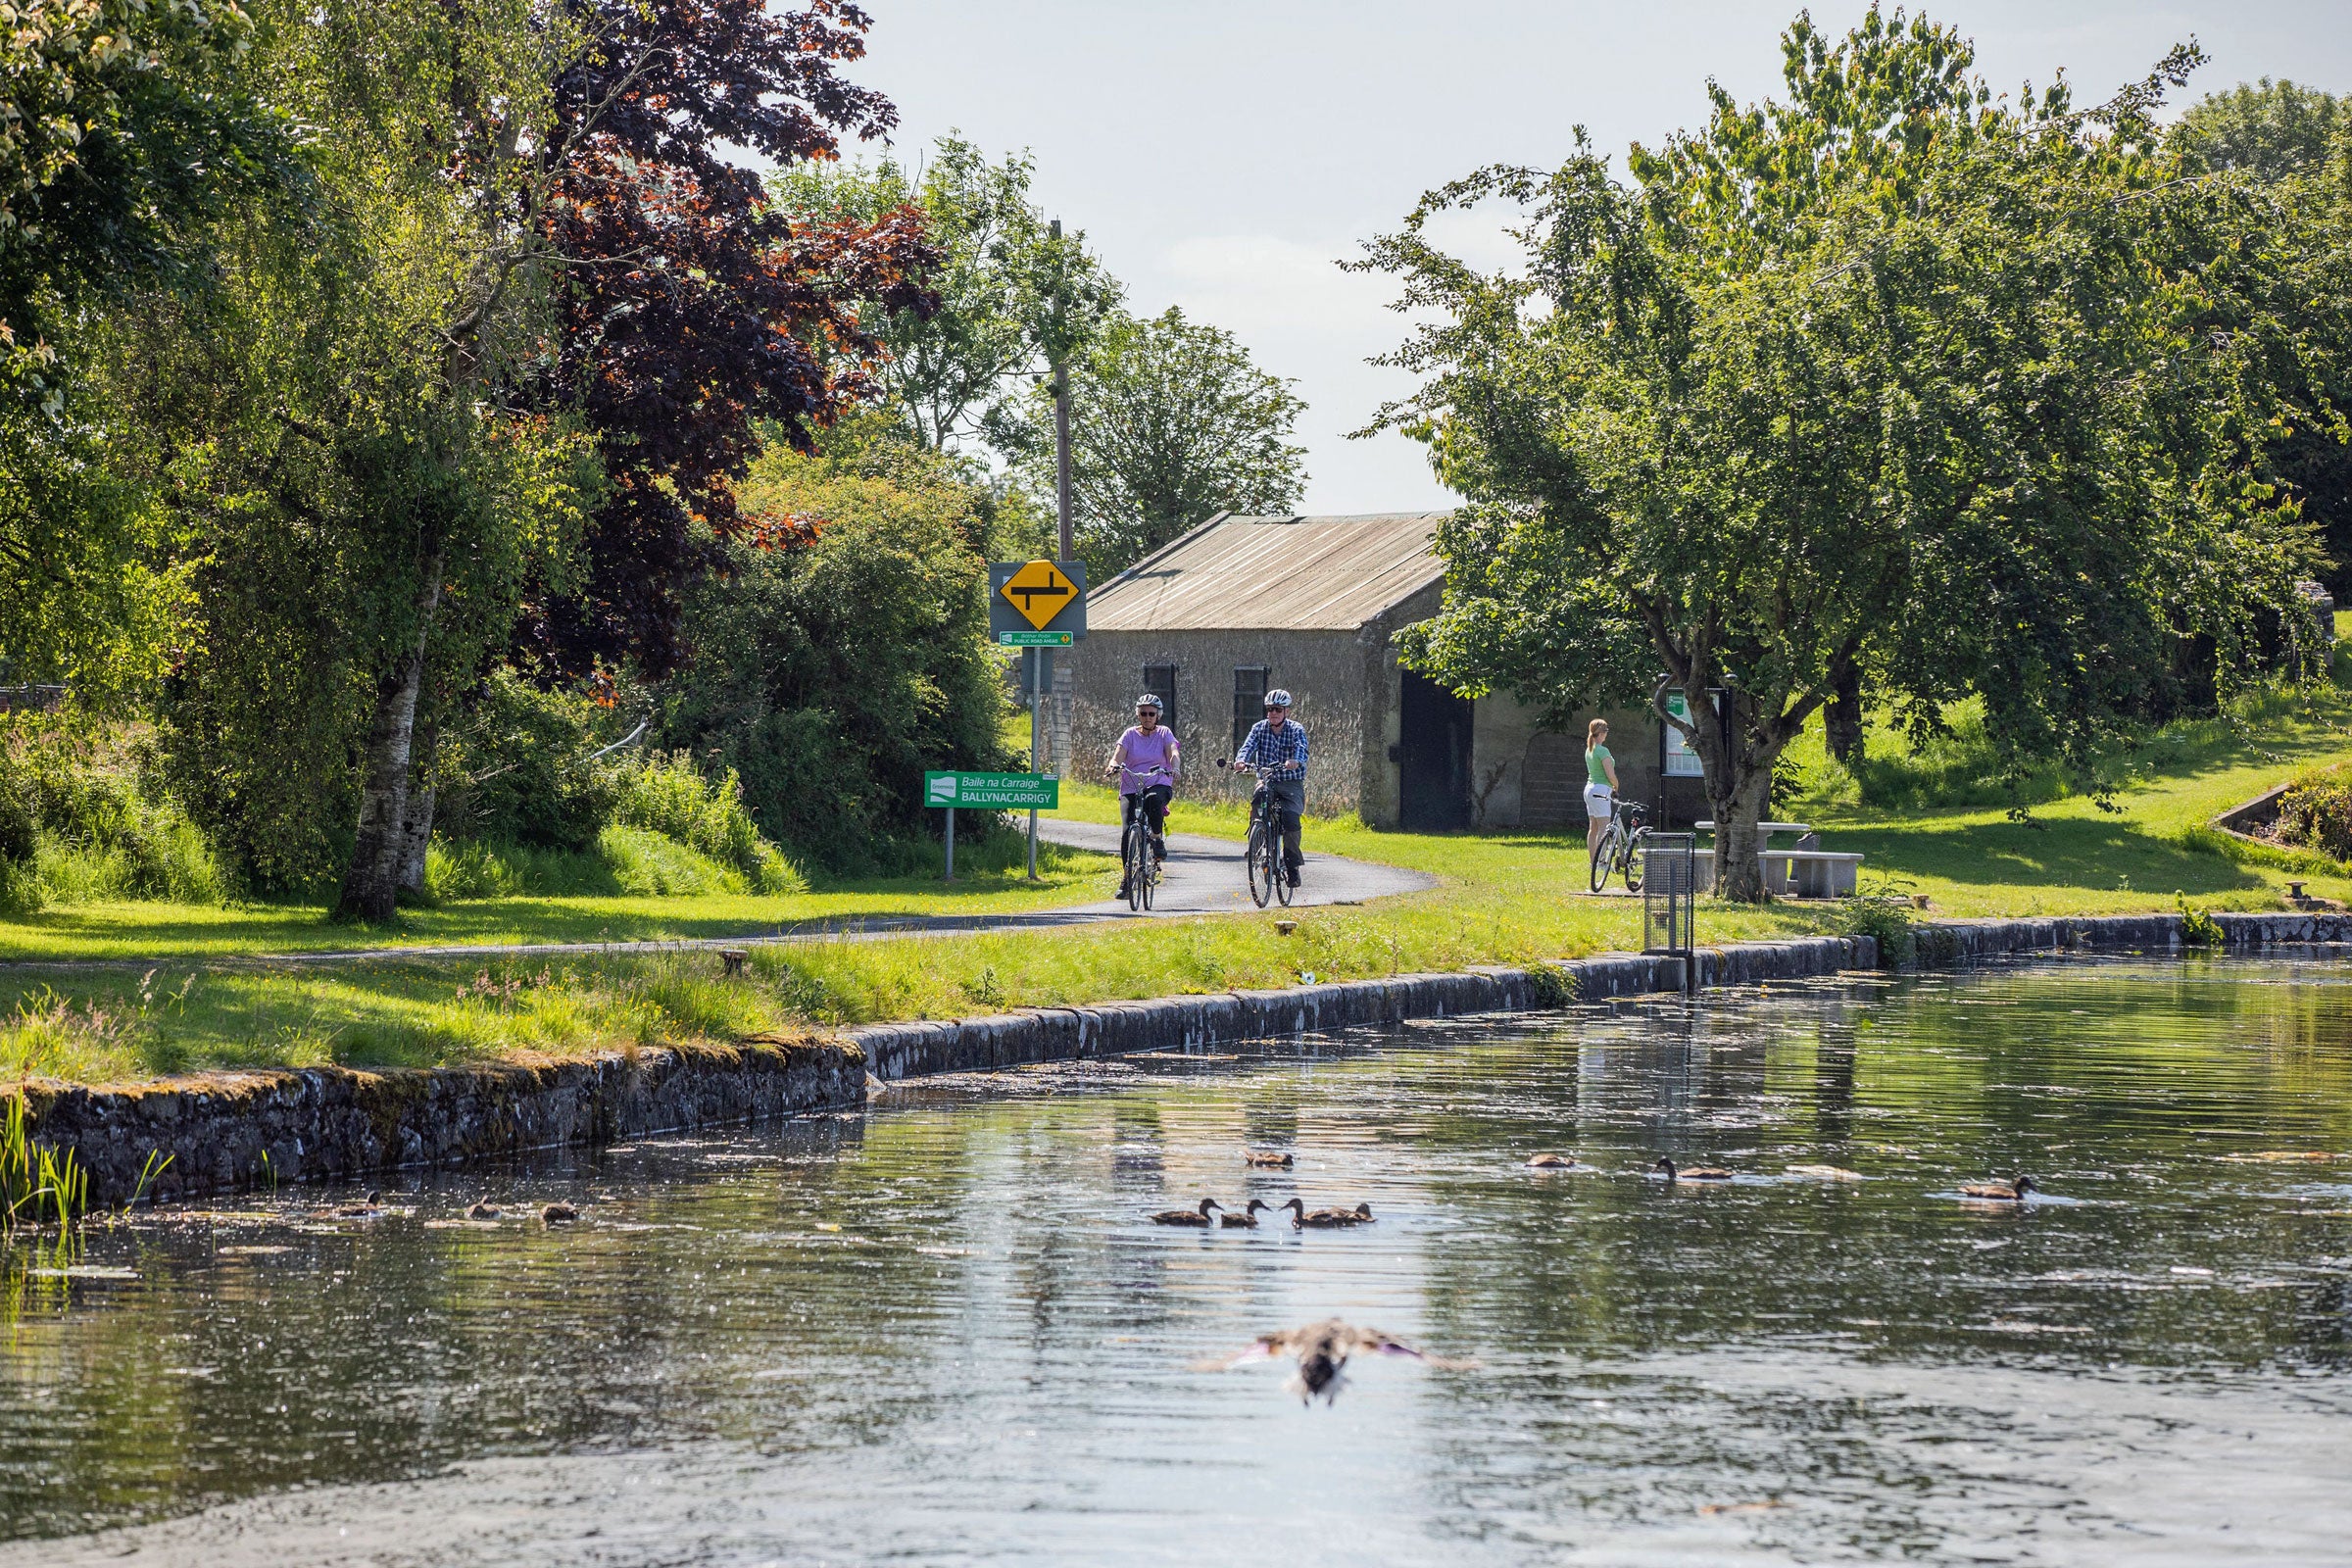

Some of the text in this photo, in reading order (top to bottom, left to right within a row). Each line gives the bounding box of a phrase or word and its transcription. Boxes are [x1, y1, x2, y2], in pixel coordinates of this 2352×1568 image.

[961, 776, 1040, 789] Baile na Carraige
[961, 792, 1052, 804] BALLYNACARRIGY
